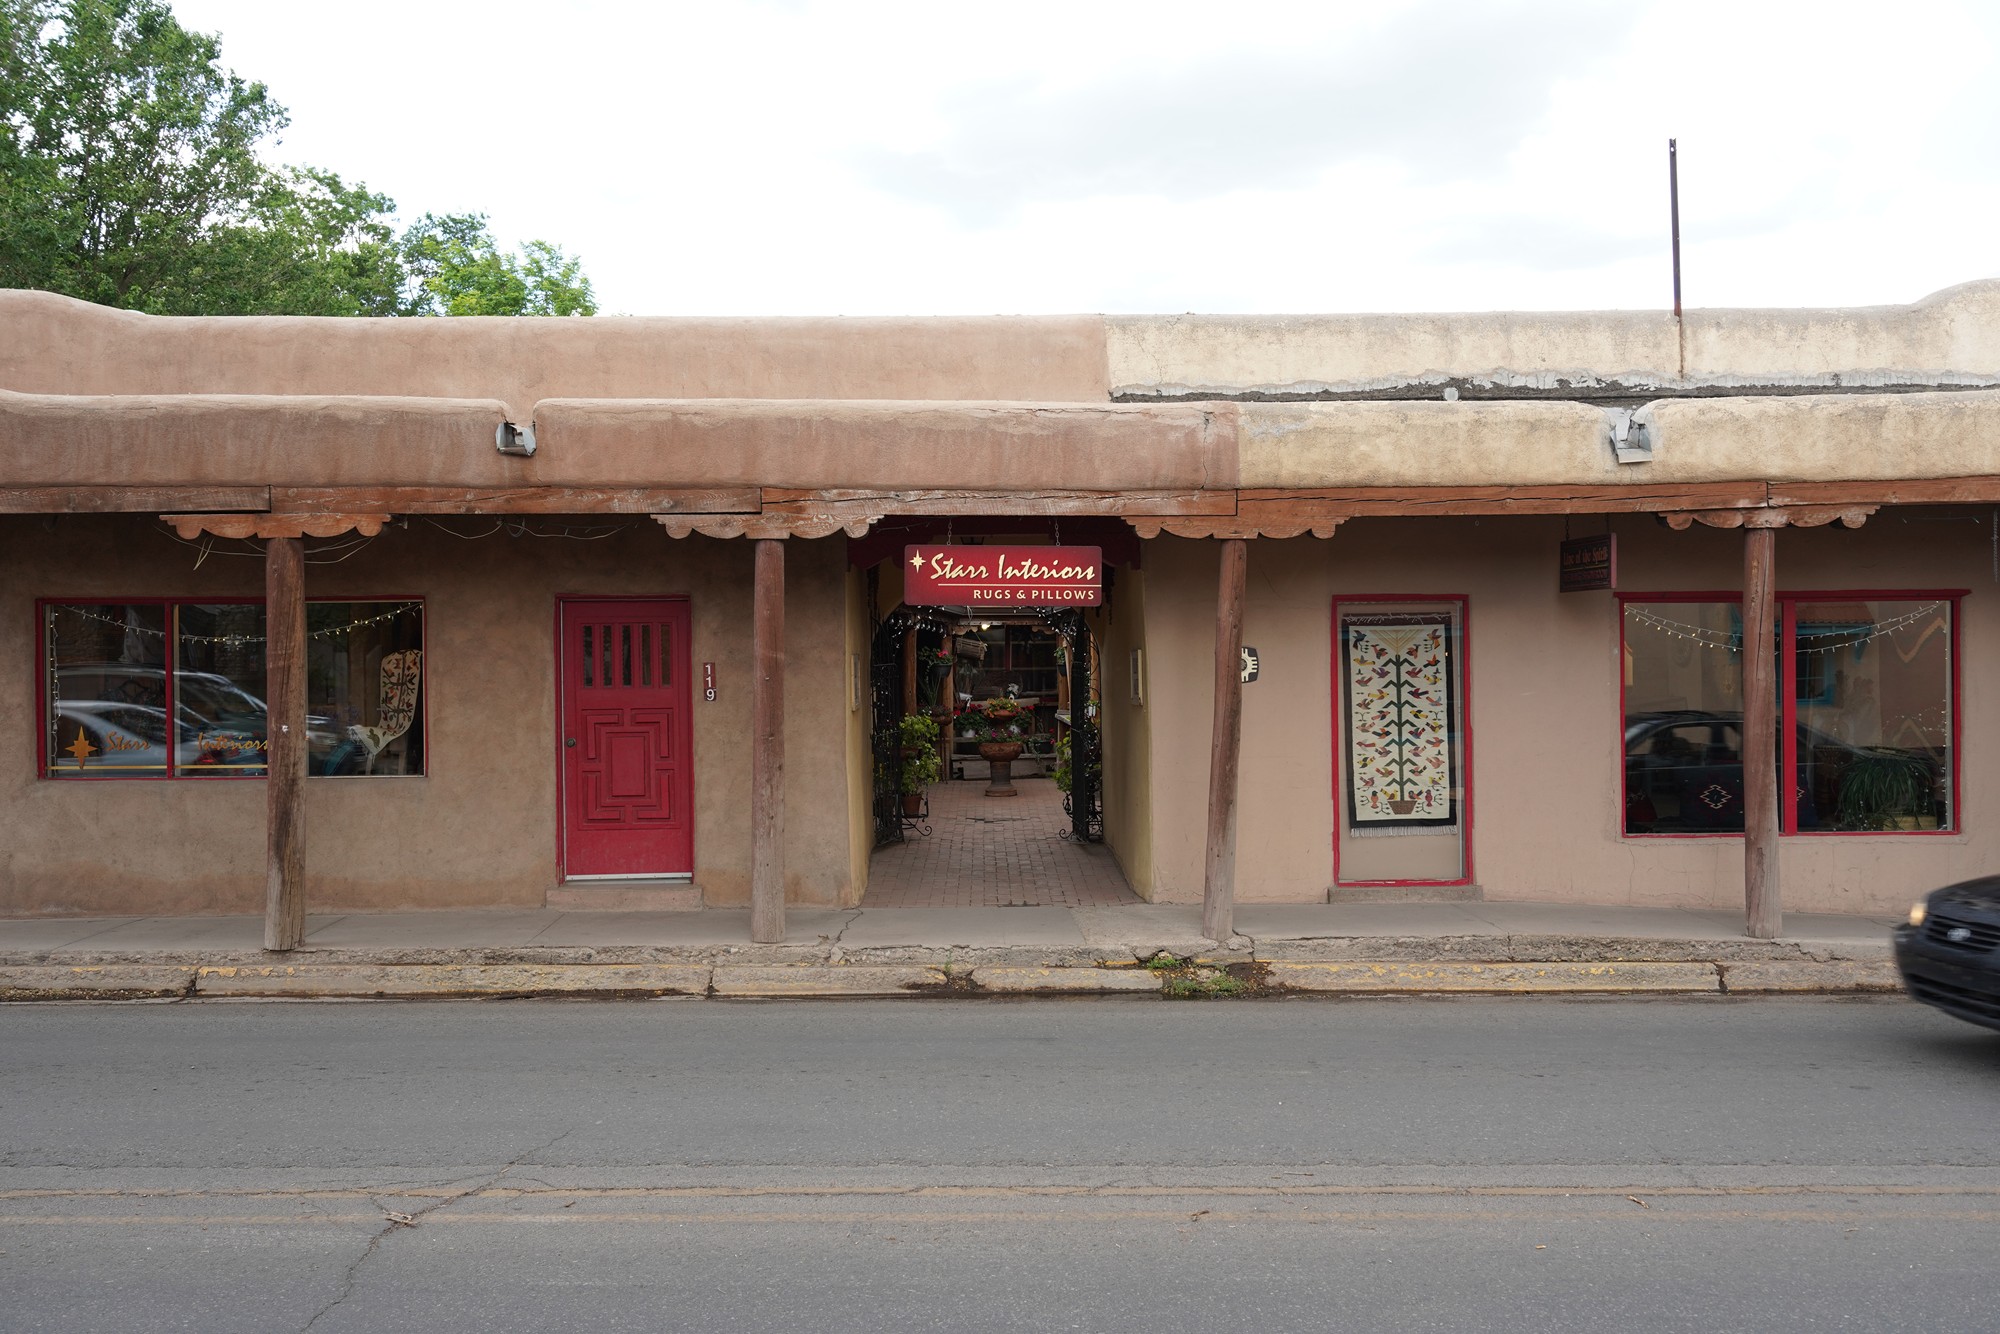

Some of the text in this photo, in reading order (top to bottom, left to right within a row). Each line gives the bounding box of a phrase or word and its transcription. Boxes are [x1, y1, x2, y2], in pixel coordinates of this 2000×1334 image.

[930, 552, 1096, 580] Starr Interiors
[973, 589, 1095, 600] RUGS & PILLOWS
[705, 663, 715, 701] 119
[106, 731, 151, 751] Starr
